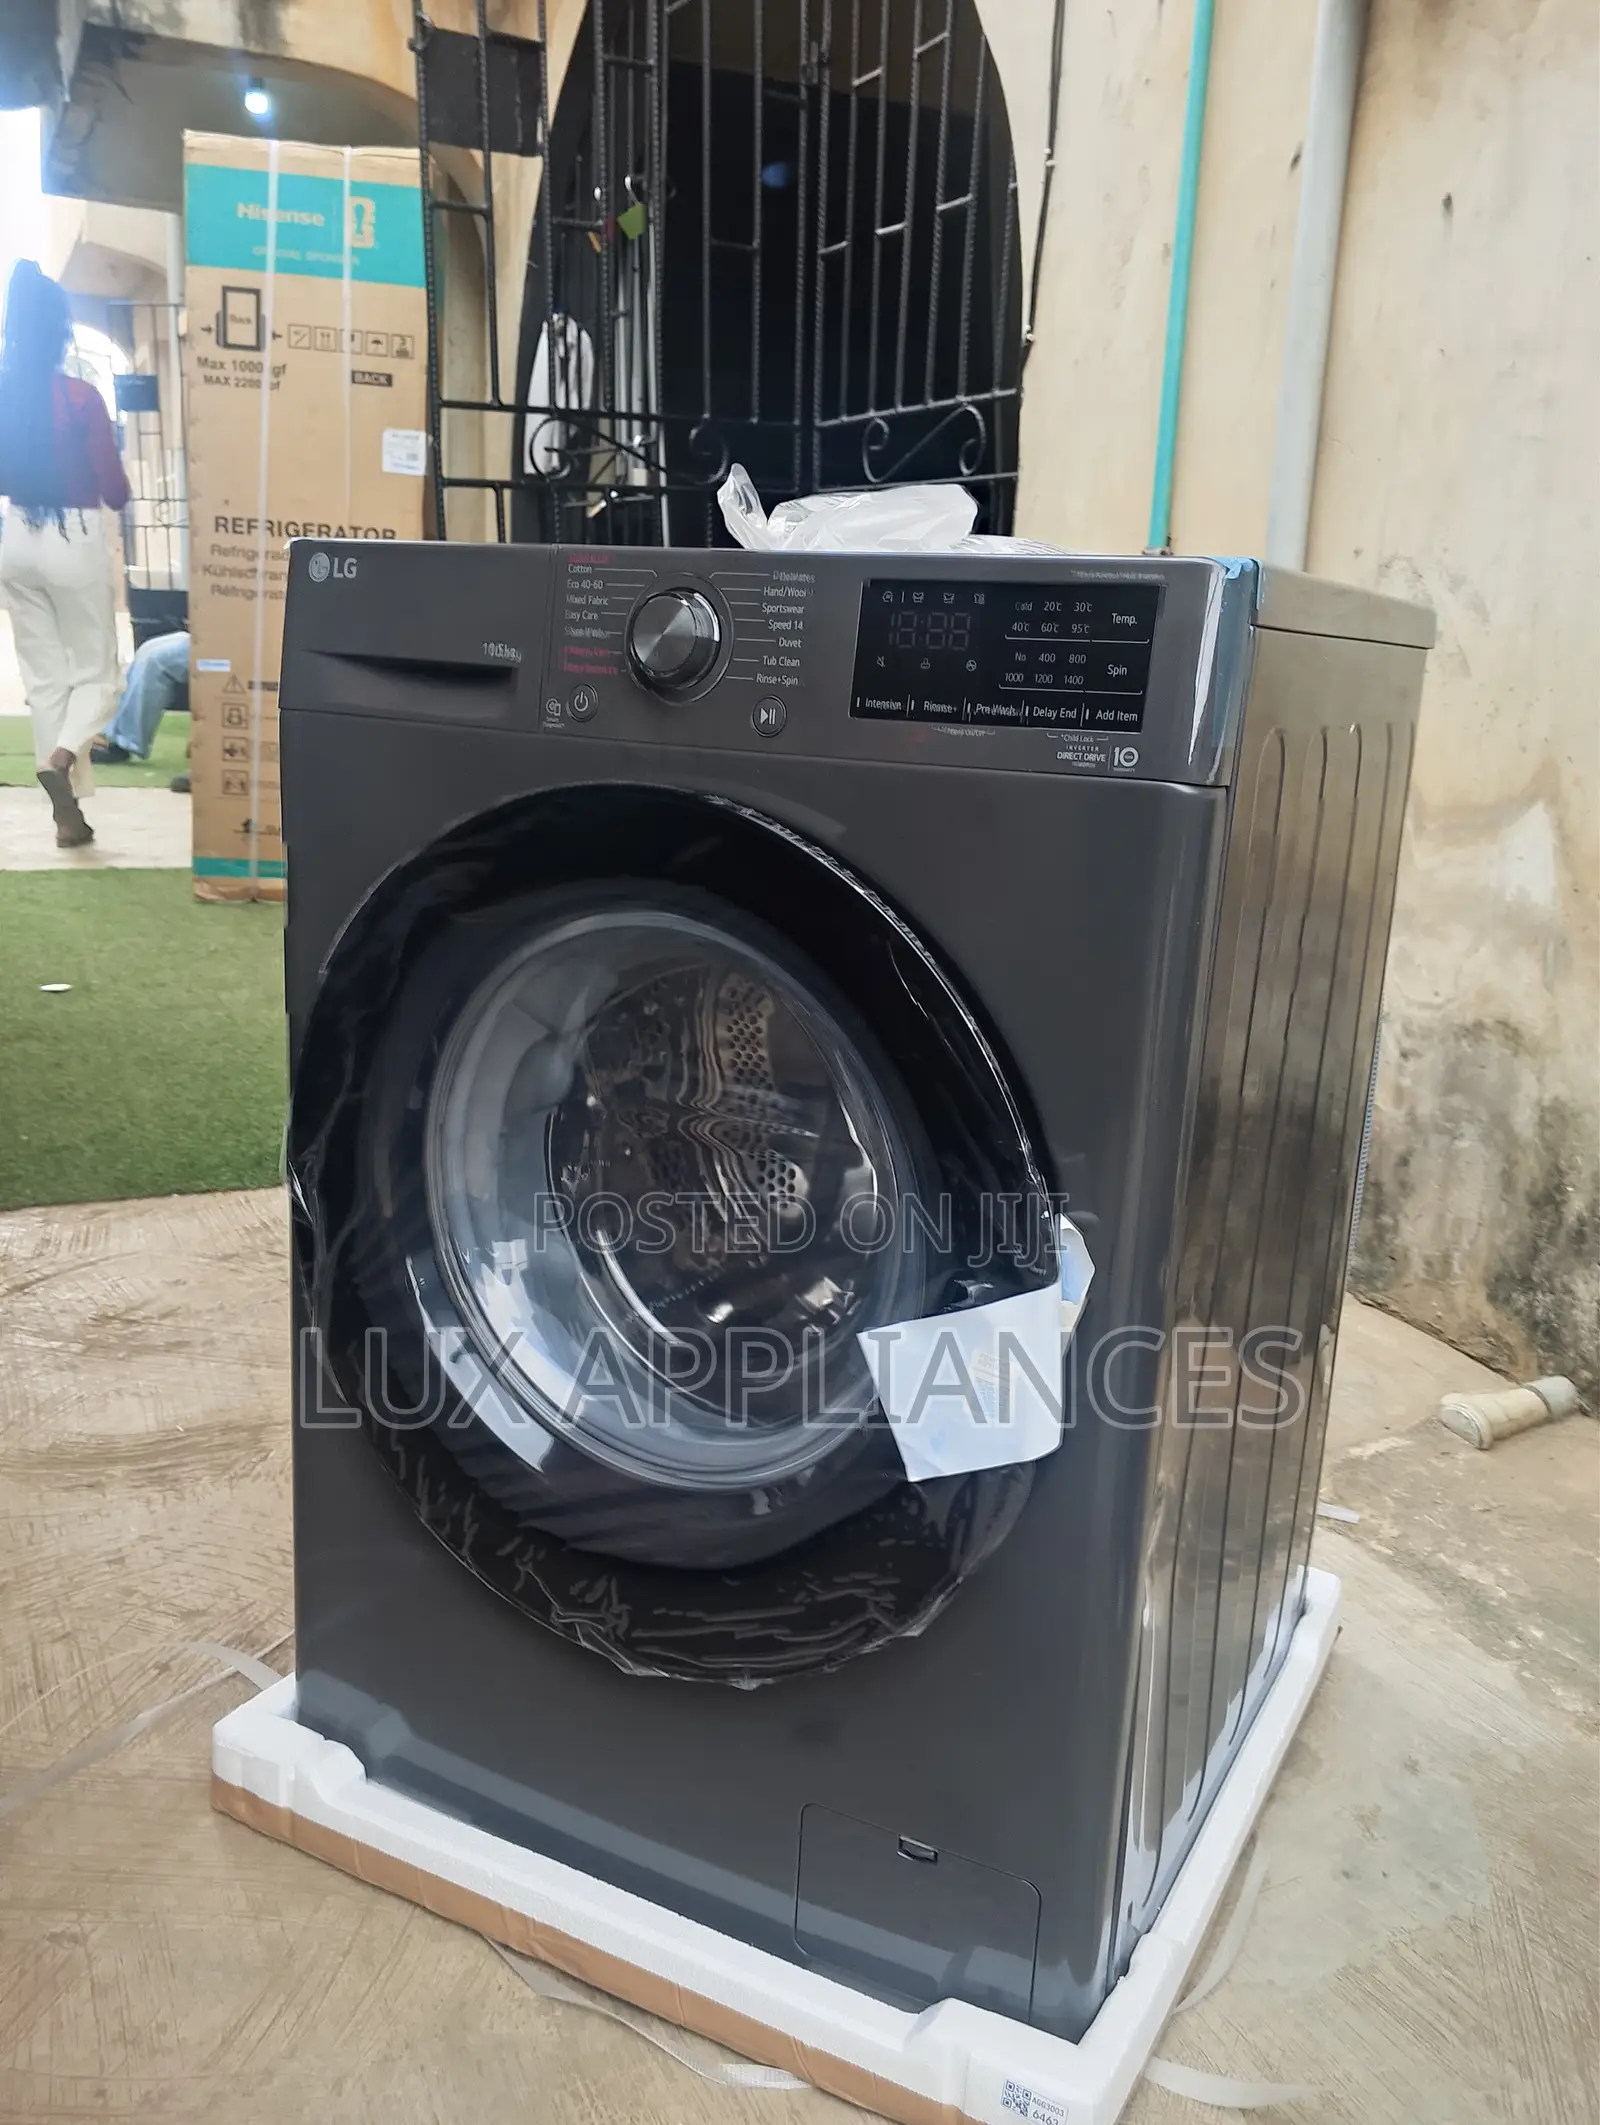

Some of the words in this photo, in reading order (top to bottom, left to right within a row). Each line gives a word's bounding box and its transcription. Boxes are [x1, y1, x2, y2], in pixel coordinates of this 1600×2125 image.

[197, 357, 226, 371] Max
[204, 374, 231, 387] MAX
[214, 516, 397, 540] REFRIGERATOR
[333, 557, 357, 579] LG
[568, 564, 592, 574] Cotton
[567, 579, 579, 588] Eco
[581, 580, 603, 590] 40-60
[588, 596, 608, 605] Fabric
[762, 602, 805, 614] Sportswear
[1014, 602, 1033, 612] Cold
[582, 610, 599, 620] Care
[1112, 613, 1138, 627] Temp.
[768, 619, 792, 631] Speed
[794, 620, 804, 630] 14
[778, 637, 802, 648] Duvet
[763, 655, 777, 666] Tub
[779, 656, 800, 667] Clean
[1015, 652, 1027, 661] No
[1038, 652, 1056, 663] 400
[1068, 654, 1087, 664] 800
[1107, 664, 1128, 677] Spin
[756, 674, 799, 687] Rinse+Spin
[1005, 673, 1024, 683] 1000
[1035, 673, 1053, 684] 1200
[1064, 675, 1084, 685] 1400
[1033, 706, 1057, 720] Delay
[1060, 707, 1077, 719] End
[1096, 710, 1115, 721] Add
[1117, 711, 1138, 722] Item
[1080, 735, 1094, 743] Lock
[1057, 751, 1082, 761] DIRECT
[1084, 752, 1106, 762] DRIVE
